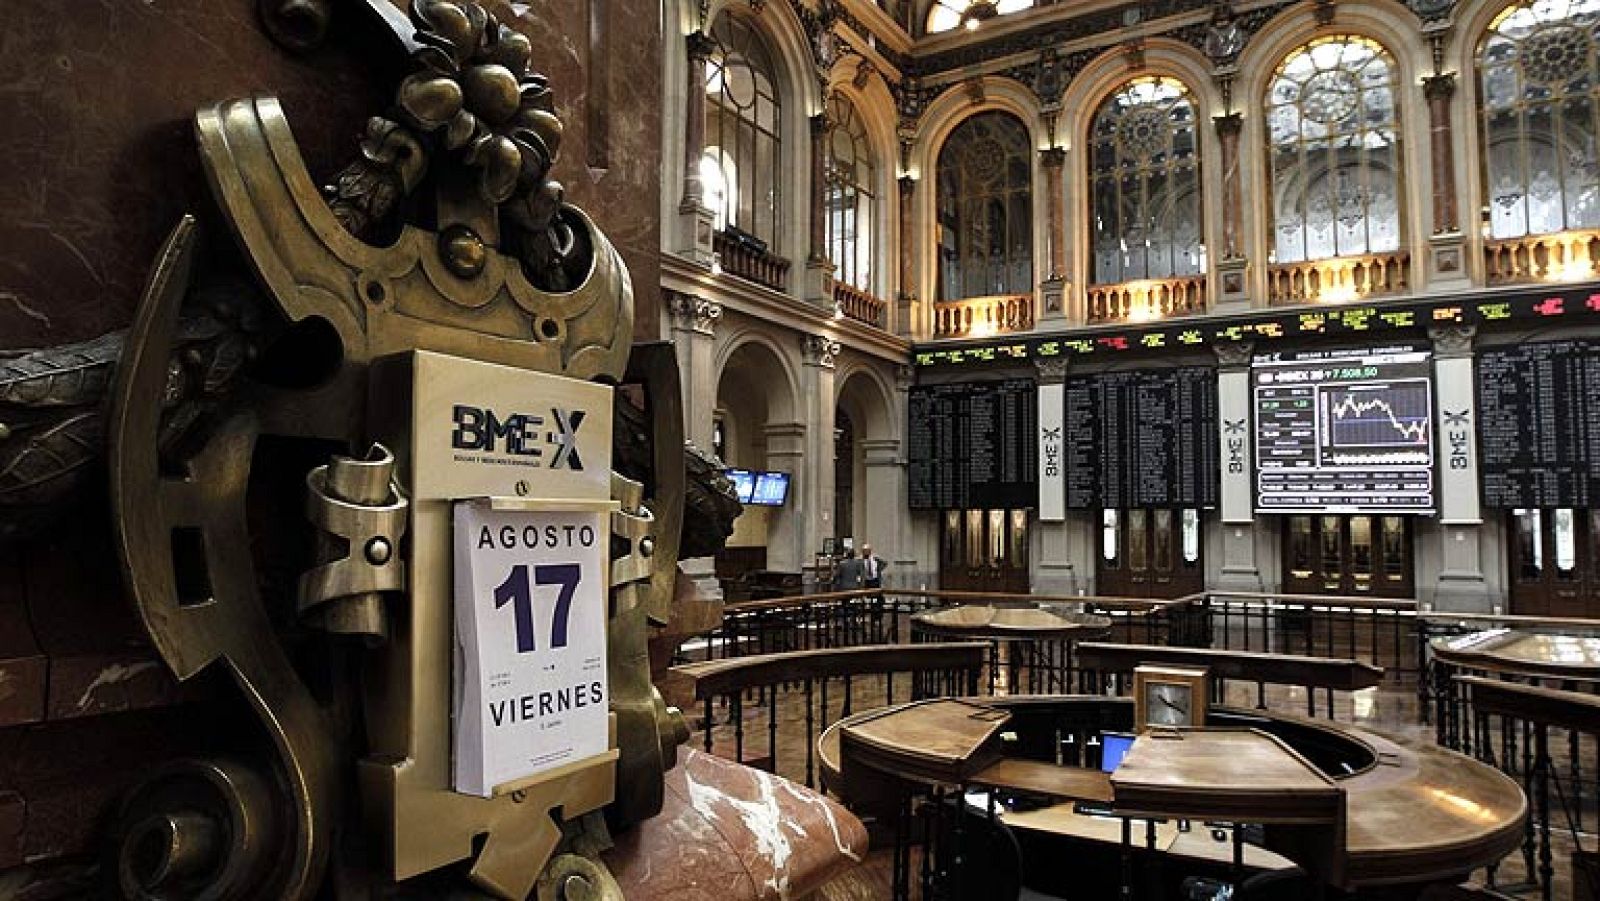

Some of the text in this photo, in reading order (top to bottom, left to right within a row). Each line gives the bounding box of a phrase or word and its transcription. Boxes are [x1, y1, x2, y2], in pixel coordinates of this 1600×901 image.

[478, 524, 595, 549] AGOSTO
[493, 563, 582, 653] 17
[489, 681, 603, 727] VIERNES
